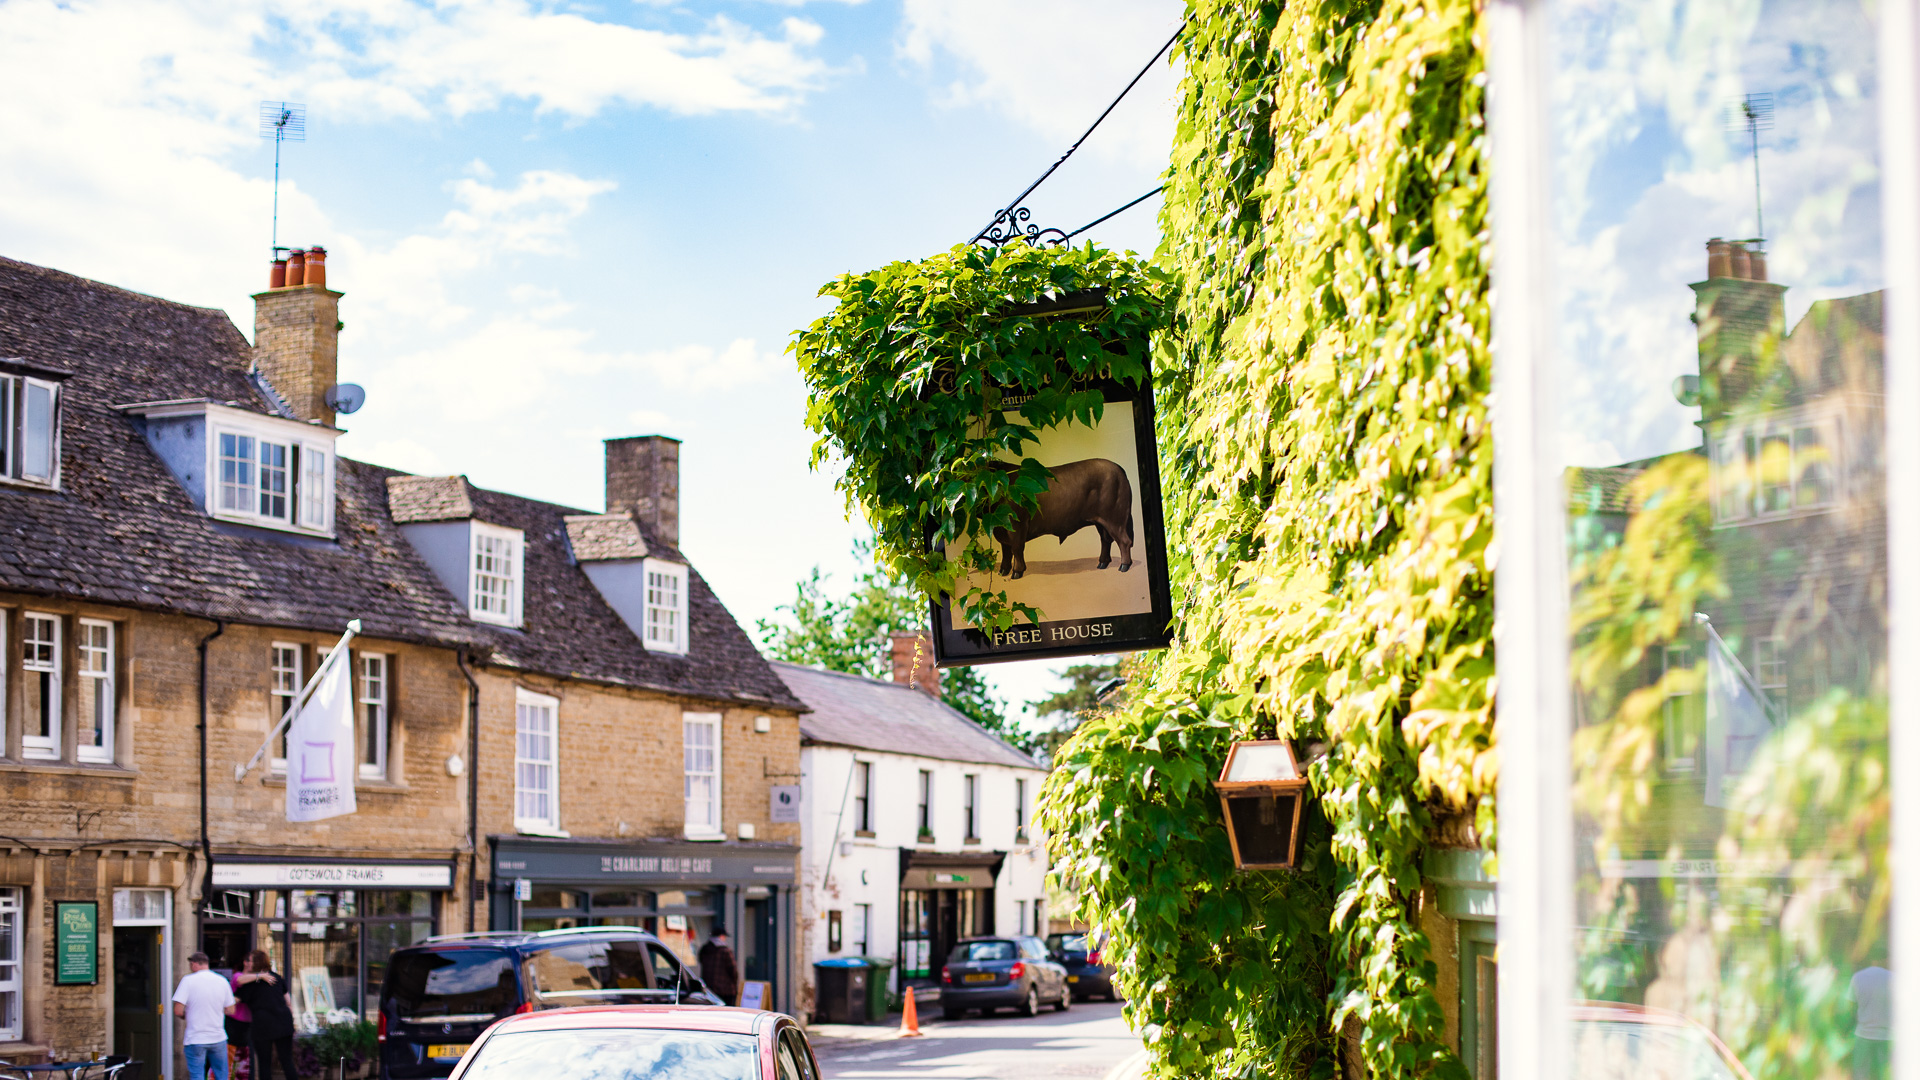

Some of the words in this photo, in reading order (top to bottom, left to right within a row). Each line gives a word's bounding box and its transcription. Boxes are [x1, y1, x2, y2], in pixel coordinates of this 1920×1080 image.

[993, 629, 1042, 646] FREE
[1051, 623, 1114, 641] HOUSE
[299, 794, 340, 806] FRAMES
[612, 856, 659, 872] CHARLBURY
[661, 857, 679, 873] DELI
[289, 868, 343, 881] COTSWOLD
[346, 868, 384, 881] FRAMES
